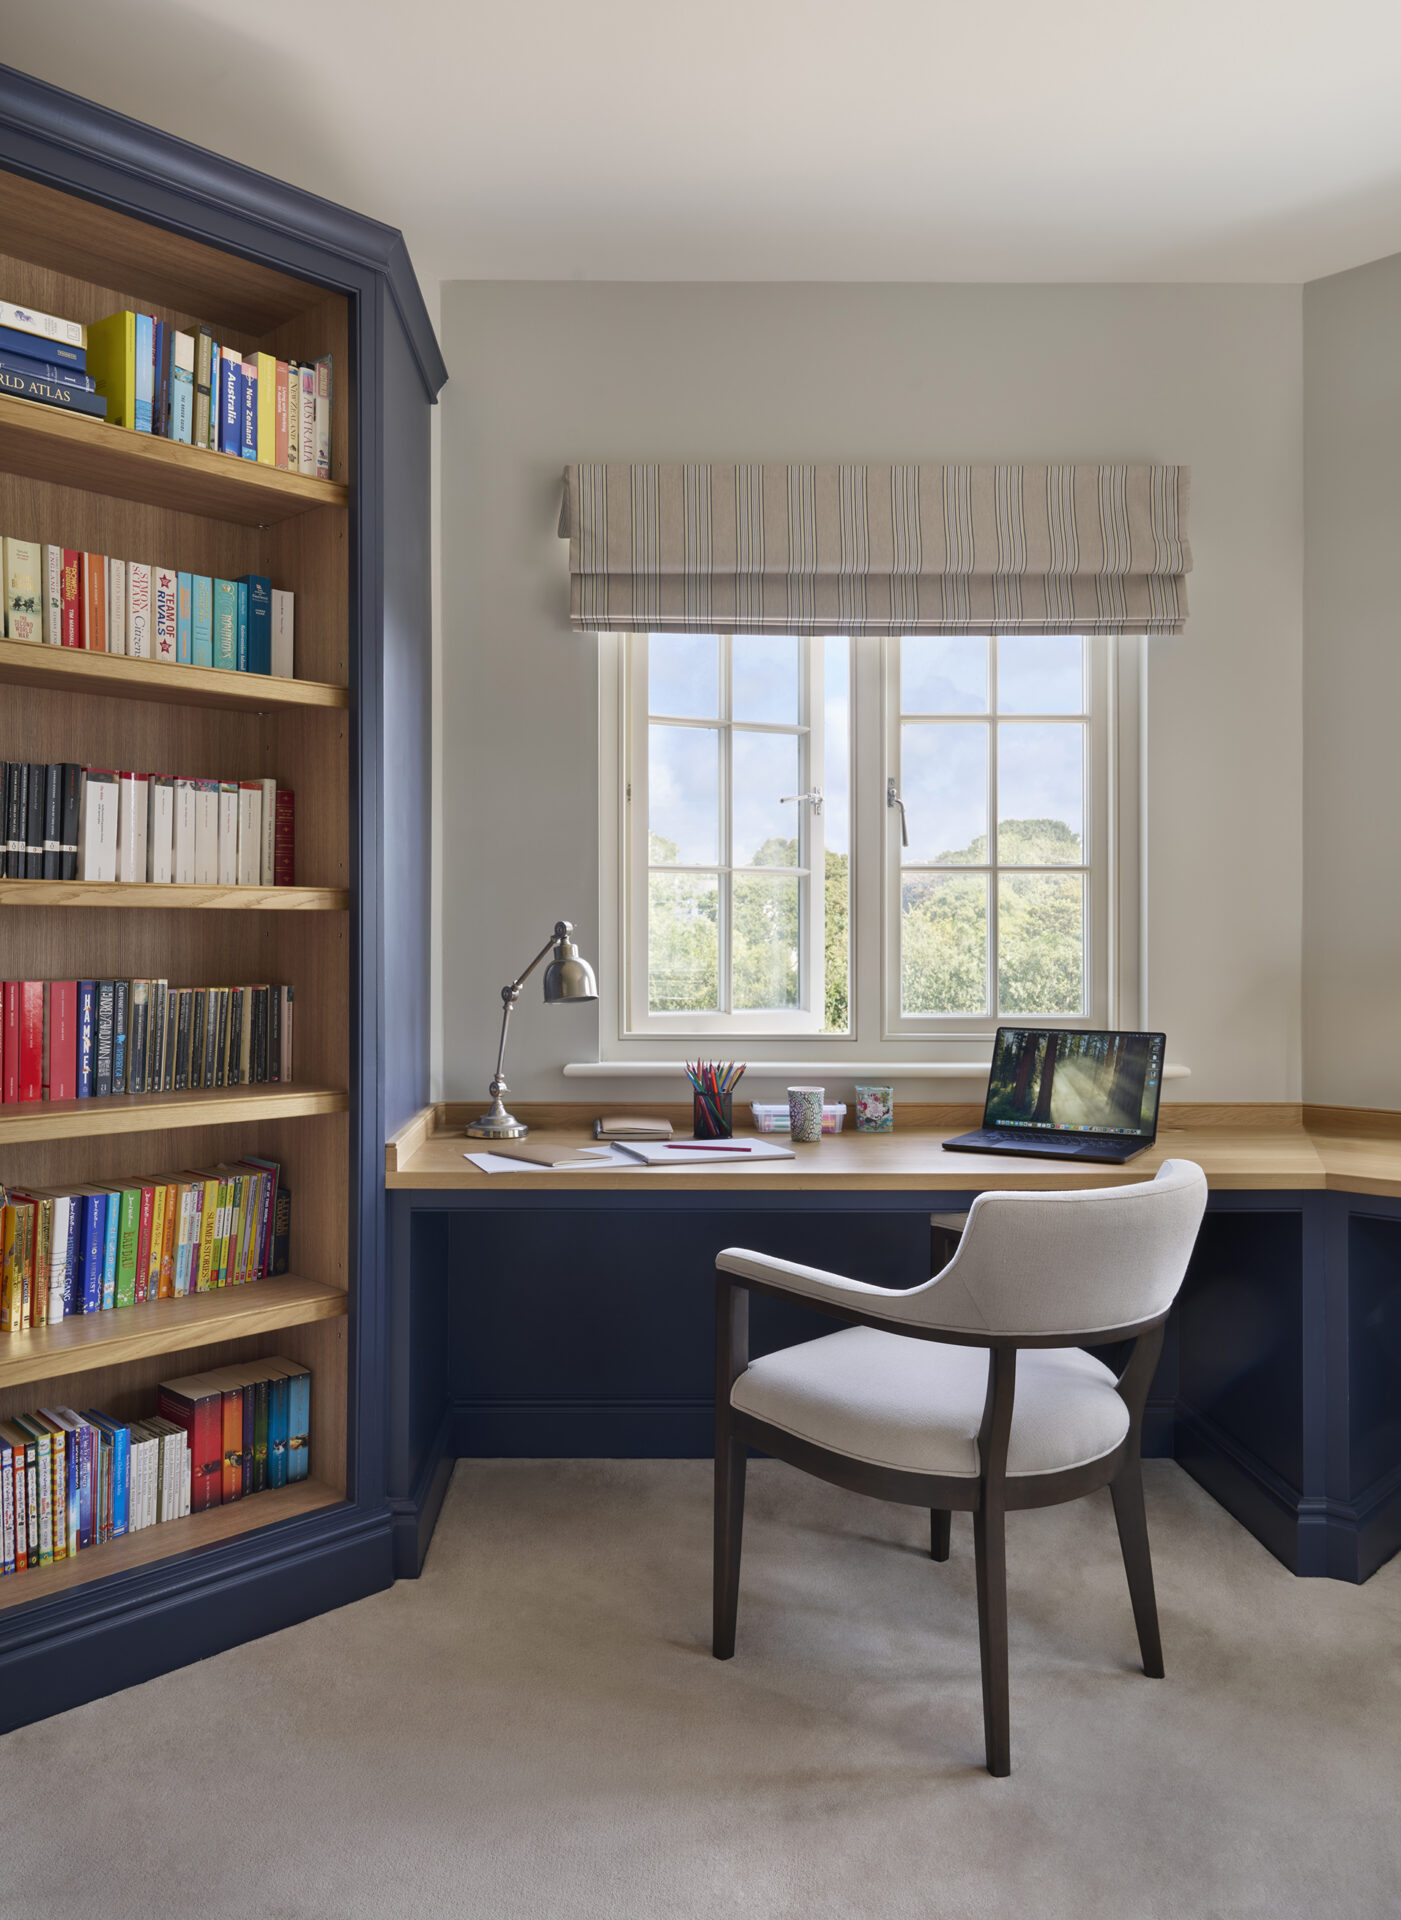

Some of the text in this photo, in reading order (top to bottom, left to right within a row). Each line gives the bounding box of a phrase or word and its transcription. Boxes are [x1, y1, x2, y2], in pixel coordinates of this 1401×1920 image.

[29, 382, 71, 402] ATLAS
[228, 372, 236, 424] Australia
[303, 398, 313, 463] AUSTRALIA
[132, 566, 140, 614] SCHAMA
[140, 572, 149, 610] SIMON
[133, 616, 145, 657] Citizens
[166, 593, 175, 638] TEAM OF
[83, 994, 91, 1084] HAMNET
[98, 1040, 111, 1060] MAN
[121, 1231, 136, 1269] BAD DAD
[202, 1212, 214, 1278] SUMMER STORIES
[63, 1237, 74, 1302] MIDNIGHT GANG
[89, 1262, 97, 1294] DENTIST
